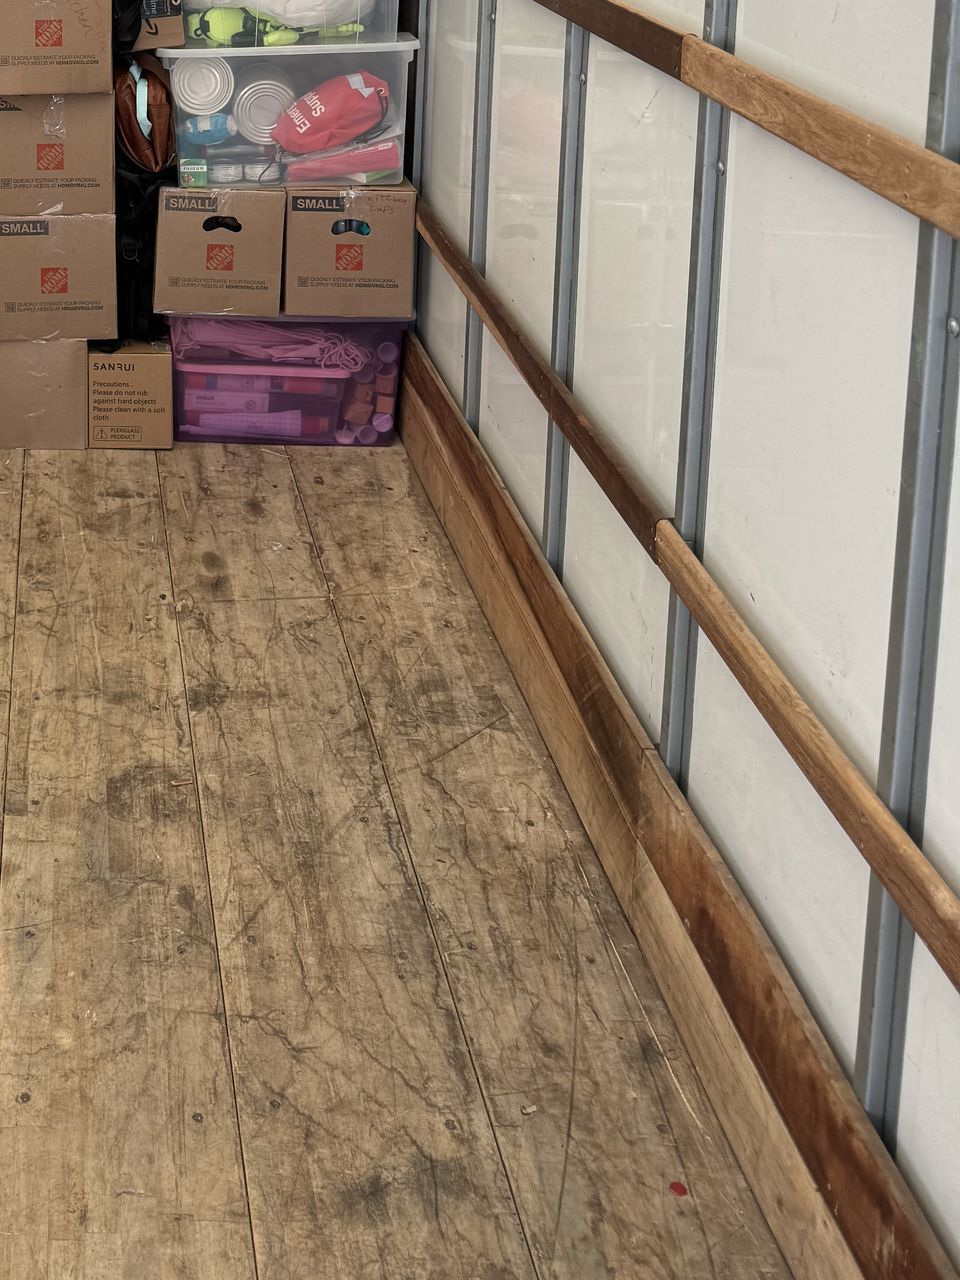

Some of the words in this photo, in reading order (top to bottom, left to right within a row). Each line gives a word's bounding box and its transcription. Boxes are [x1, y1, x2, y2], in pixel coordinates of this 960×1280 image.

[170, 198, 216, 209] SMALL
[297, 199, 340, 209] SMALL
[1, 223, 45, 234] SMALL
[93, 362, 135, 371] SANRUI
